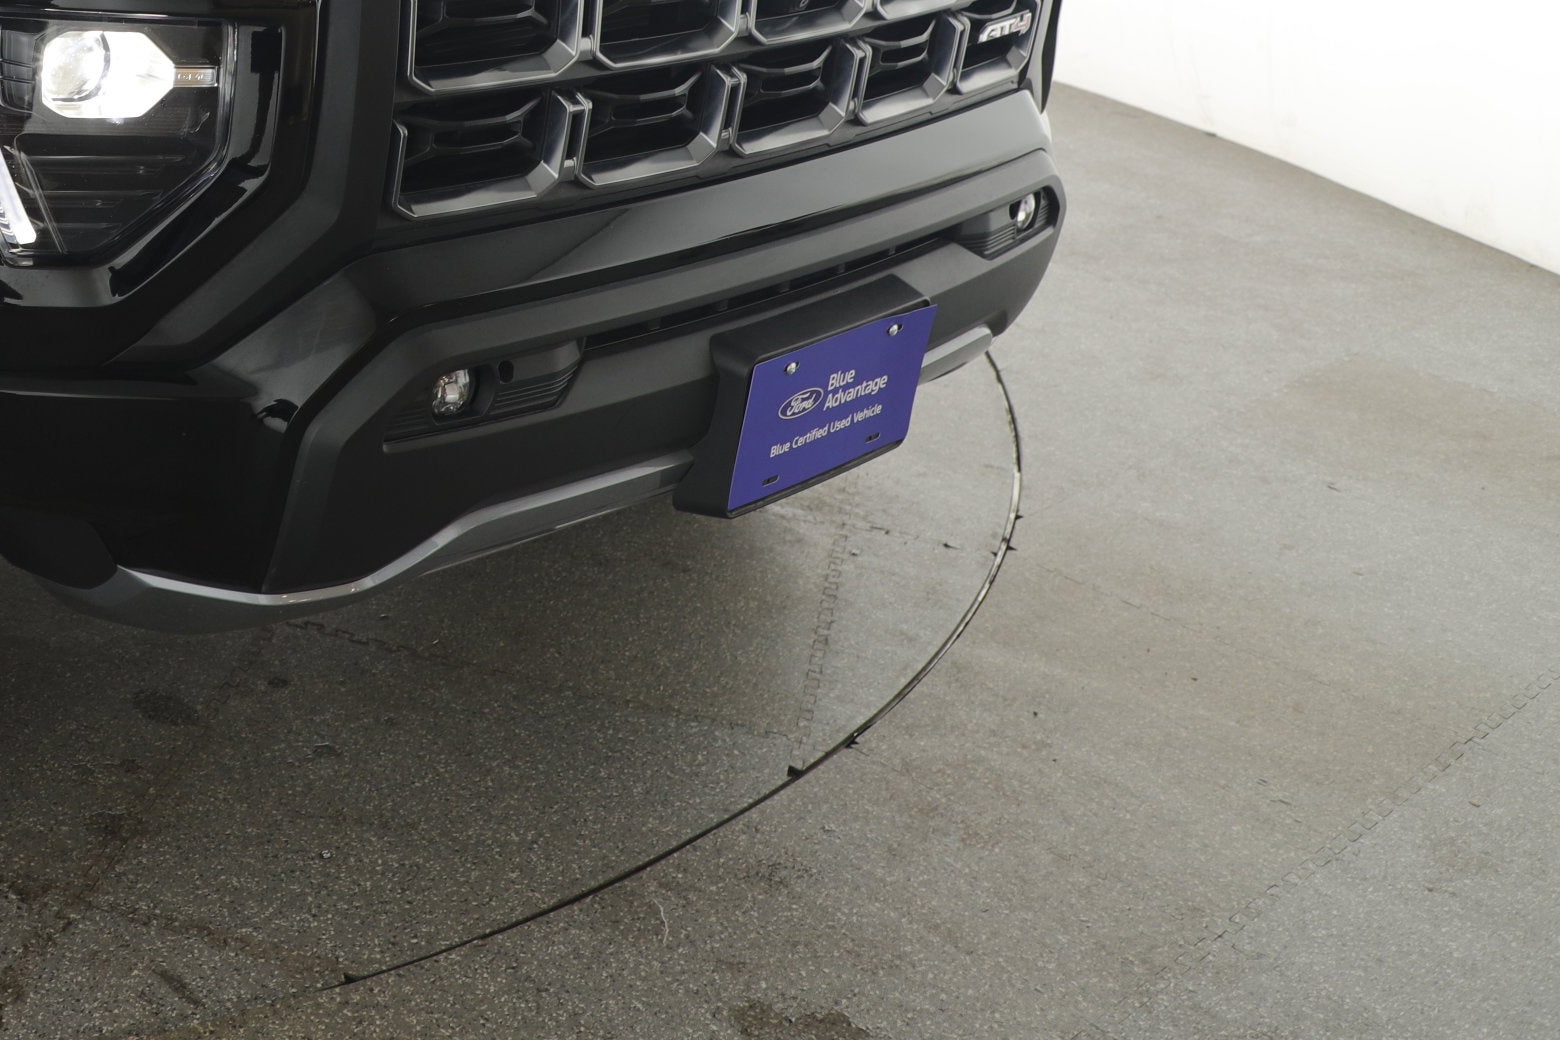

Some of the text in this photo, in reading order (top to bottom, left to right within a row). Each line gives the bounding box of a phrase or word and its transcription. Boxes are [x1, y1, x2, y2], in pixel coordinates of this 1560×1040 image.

[977, 10, 1032, 44] AT4
[823, 375, 888, 411] Advantage
[827, 369, 855, 391] Blue
[786, 391, 817, 416] Ford
[770, 403, 882, 458] Blue Certified Used Vehicle
